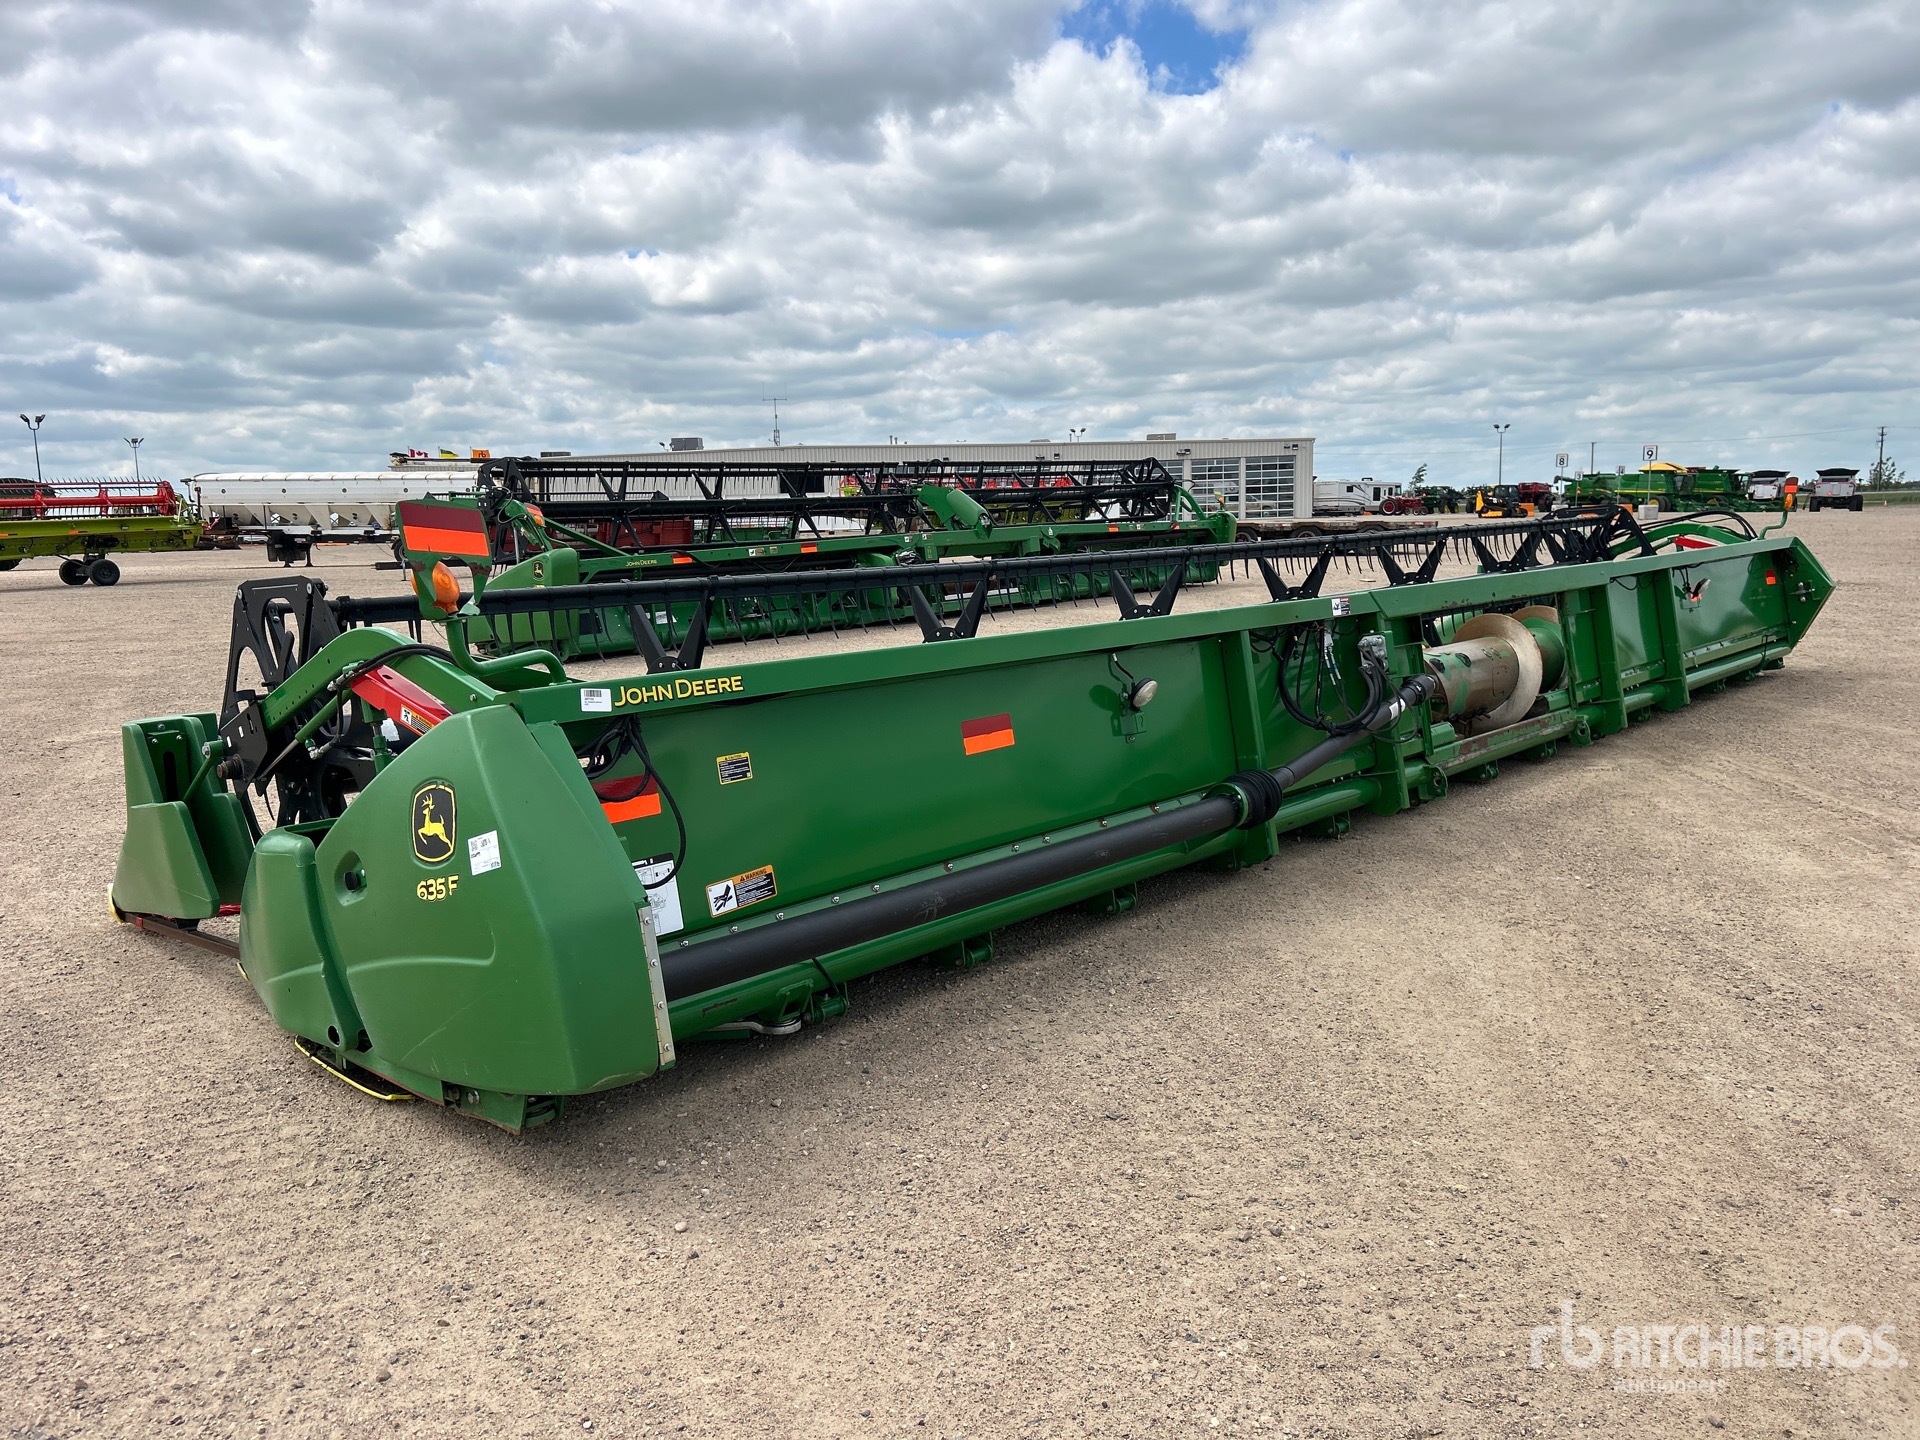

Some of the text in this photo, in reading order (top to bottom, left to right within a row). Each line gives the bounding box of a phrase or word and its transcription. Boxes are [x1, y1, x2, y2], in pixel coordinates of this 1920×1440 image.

[1646, 449, 1654, 460] 9
[1558, 457, 1565, 466] 8
[614, 675, 744, 708] JOHN DEERE
[744, 867, 768, 881] WARNING
